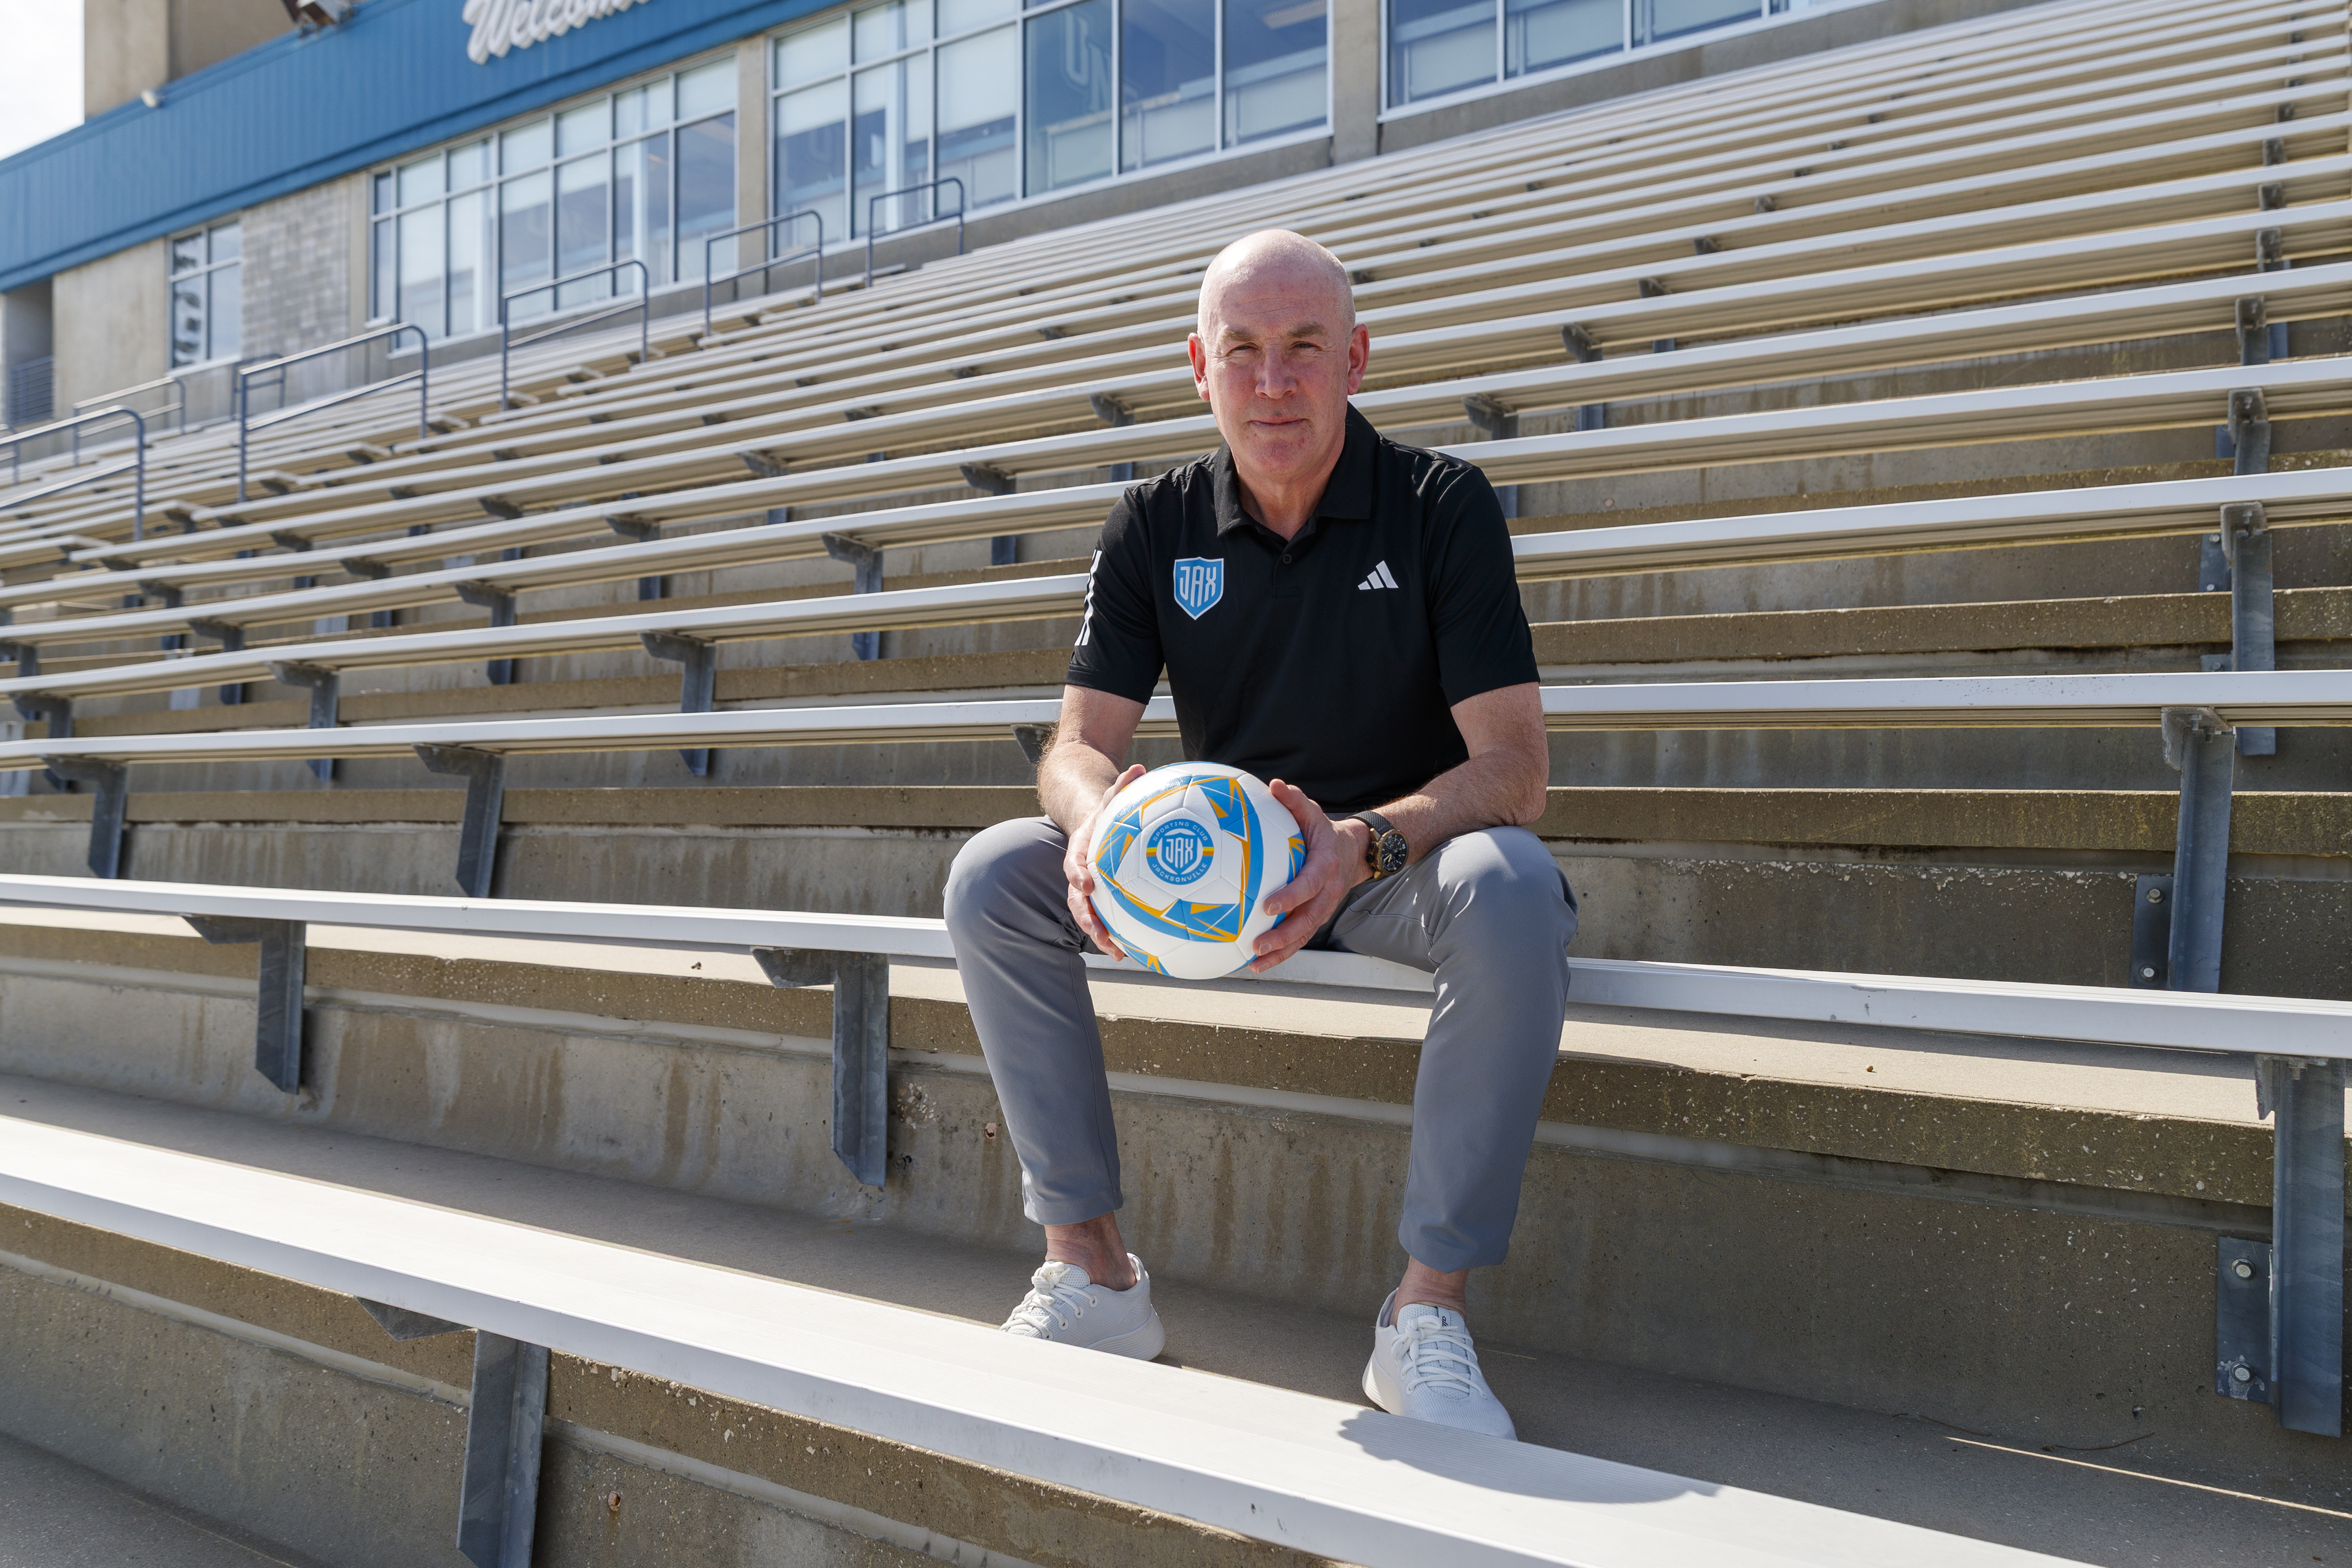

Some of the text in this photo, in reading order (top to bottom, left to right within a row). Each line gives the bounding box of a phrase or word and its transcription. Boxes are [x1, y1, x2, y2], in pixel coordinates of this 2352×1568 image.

[1180, 565, 1216, 608] JAX
[1153, 821, 1208, 841] SPORTING CLUB
[1165, 837, 1193, 868] JAX
[1152, 863, 1207, 882] JACKSONVILLE
